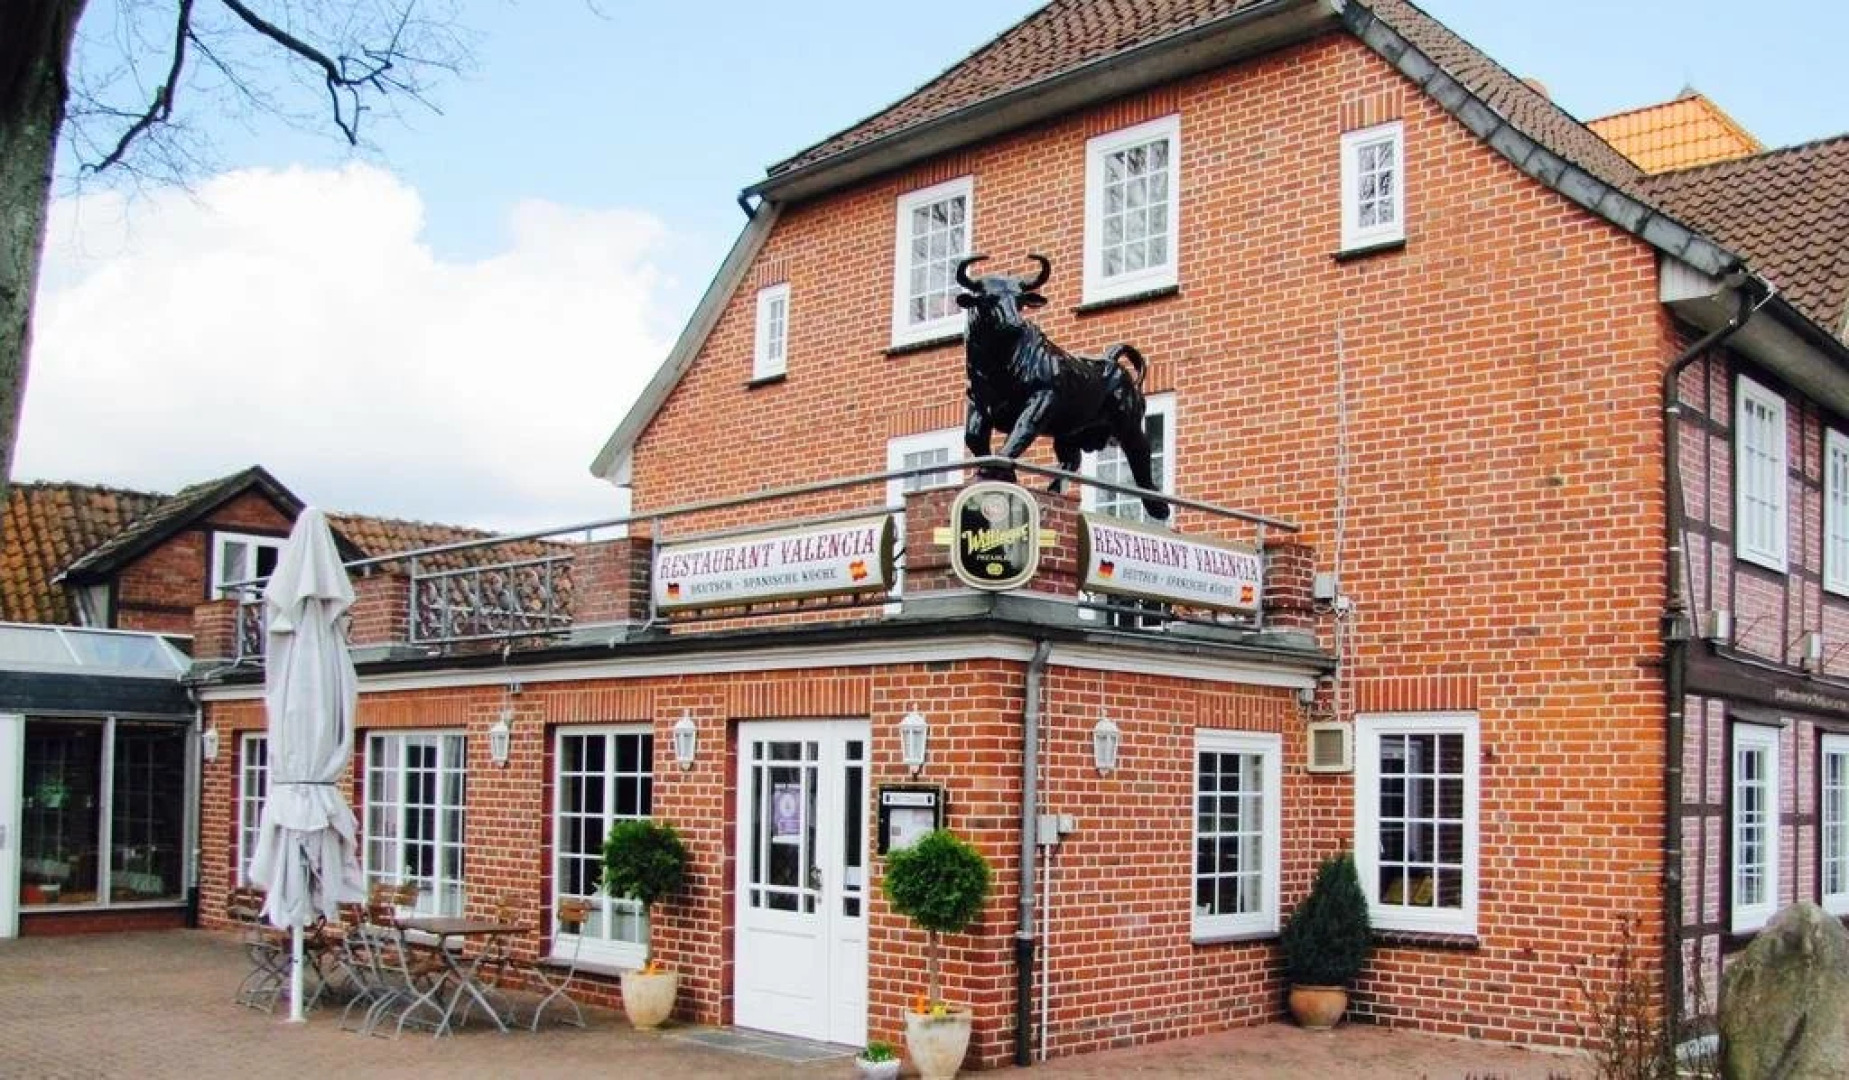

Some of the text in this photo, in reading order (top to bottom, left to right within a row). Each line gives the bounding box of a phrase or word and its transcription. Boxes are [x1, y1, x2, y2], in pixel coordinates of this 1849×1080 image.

[660, 529, 876, 579] RESTAURANT VALENCIA
[1094, 528, 1259, 582] RESTAURANT VALENCIA
[691, 581, 732, 595] DEUTSCH
[743, 575, 798, 588] SPANISCHE
[1122, 567, 1157, 583] DEUTSCH
